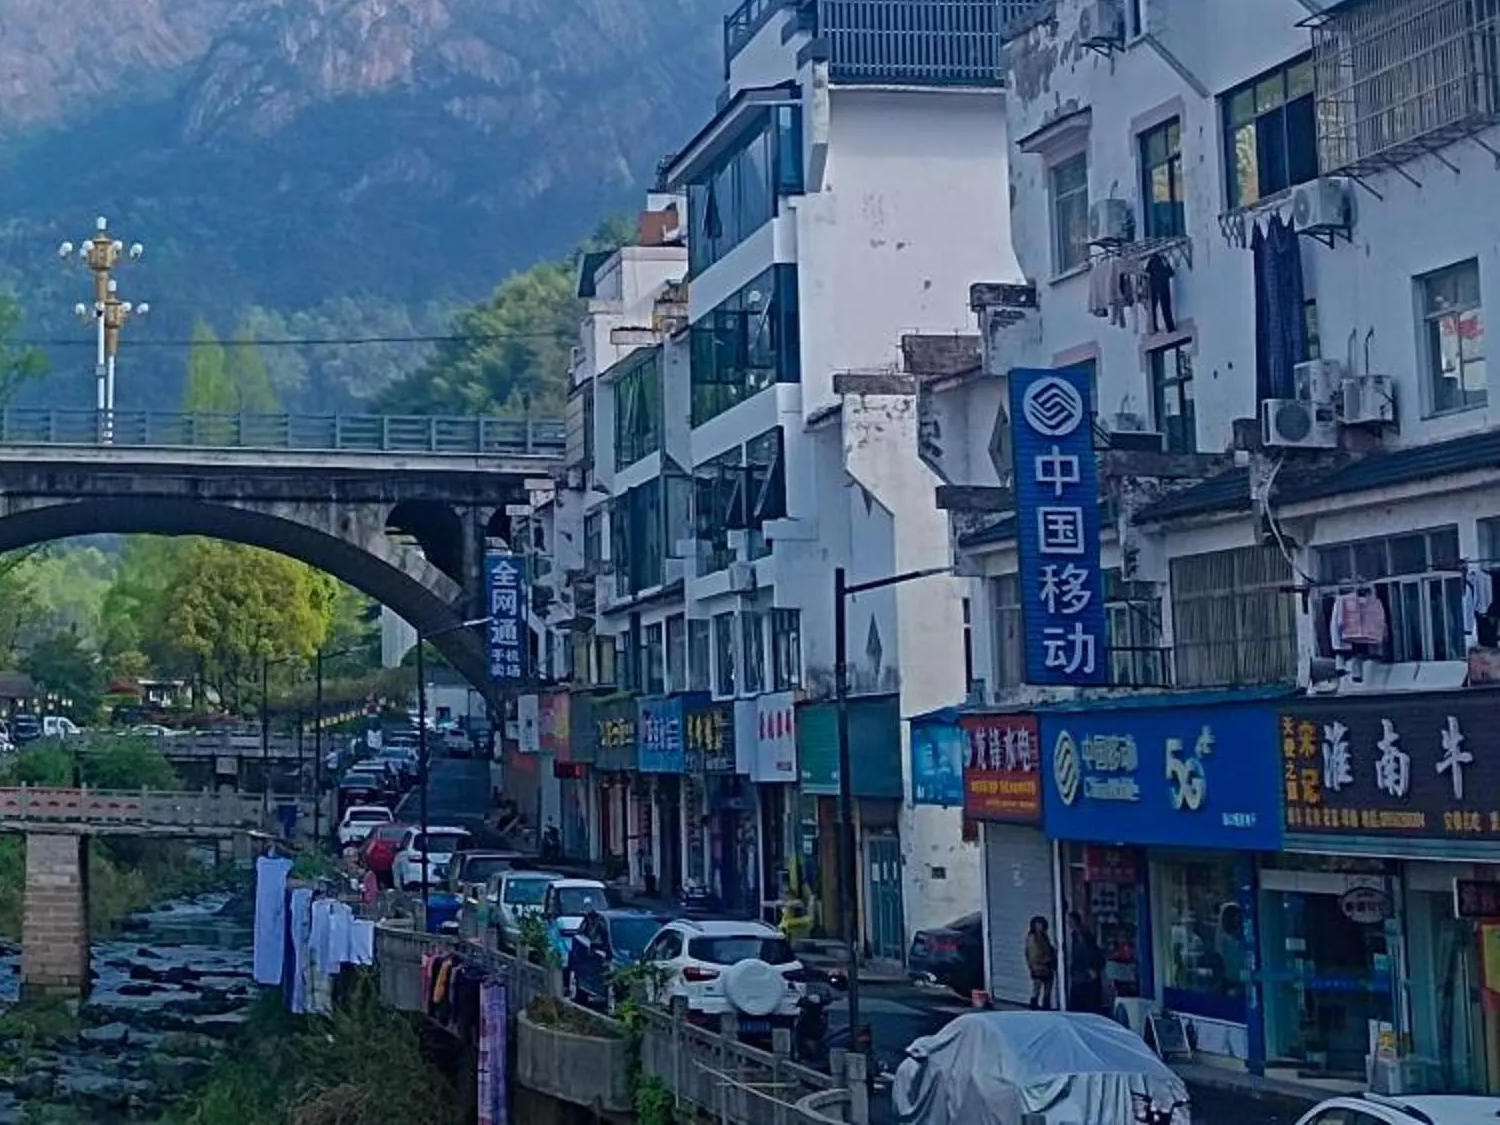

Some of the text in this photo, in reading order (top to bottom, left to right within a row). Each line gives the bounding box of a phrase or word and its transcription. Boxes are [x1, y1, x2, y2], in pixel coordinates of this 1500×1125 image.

[1035, 445, 1095, 674] 中国移动
[491, 560, 519, 646] 全网通
[1321, 715, 1474, 801] 淮南牛
